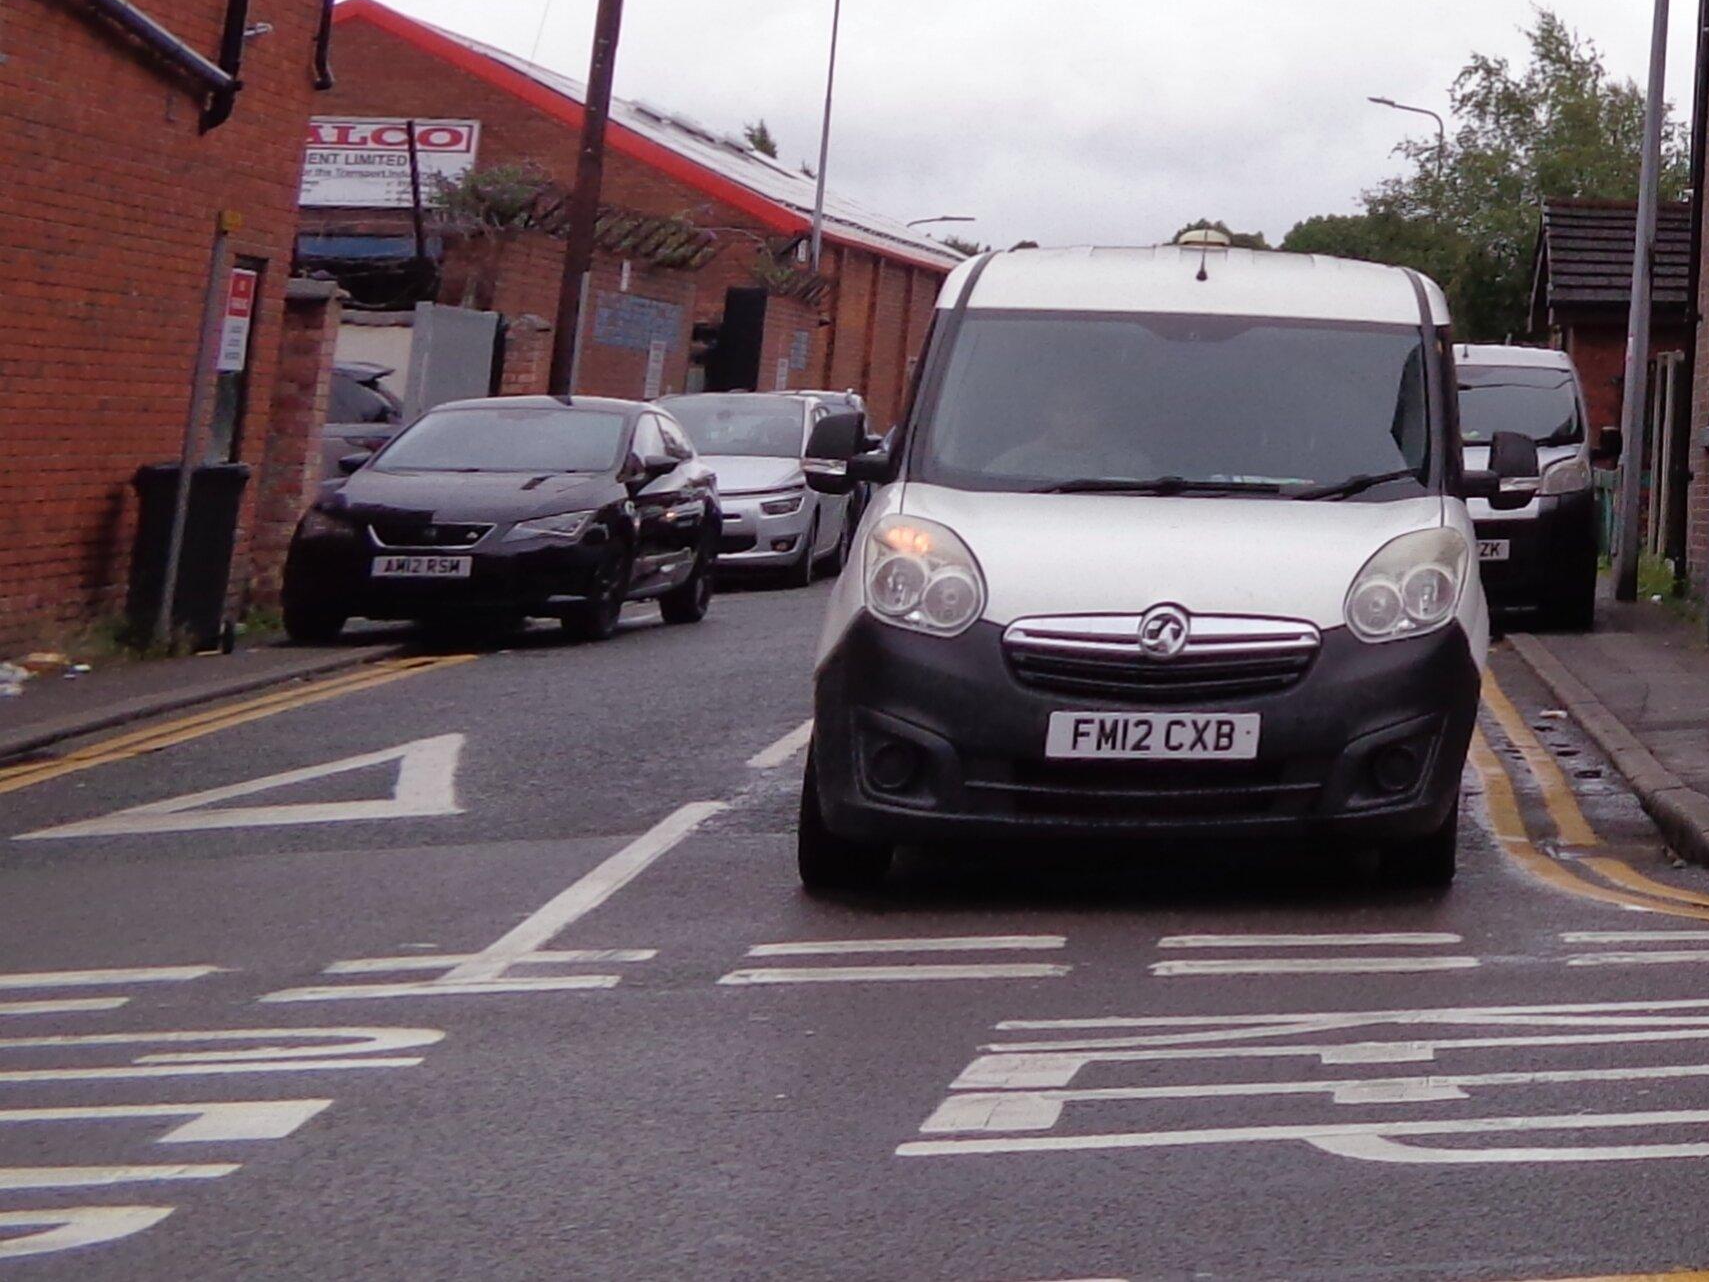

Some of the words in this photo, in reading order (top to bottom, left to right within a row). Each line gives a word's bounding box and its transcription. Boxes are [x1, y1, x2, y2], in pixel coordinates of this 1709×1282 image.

[344, 153, 408, 167] LIMITED
[1475, 541, 1501, 557] ZK
[1071, 717, 1154, 753] FM12
[1163, 718, 1235, 753] CXB
